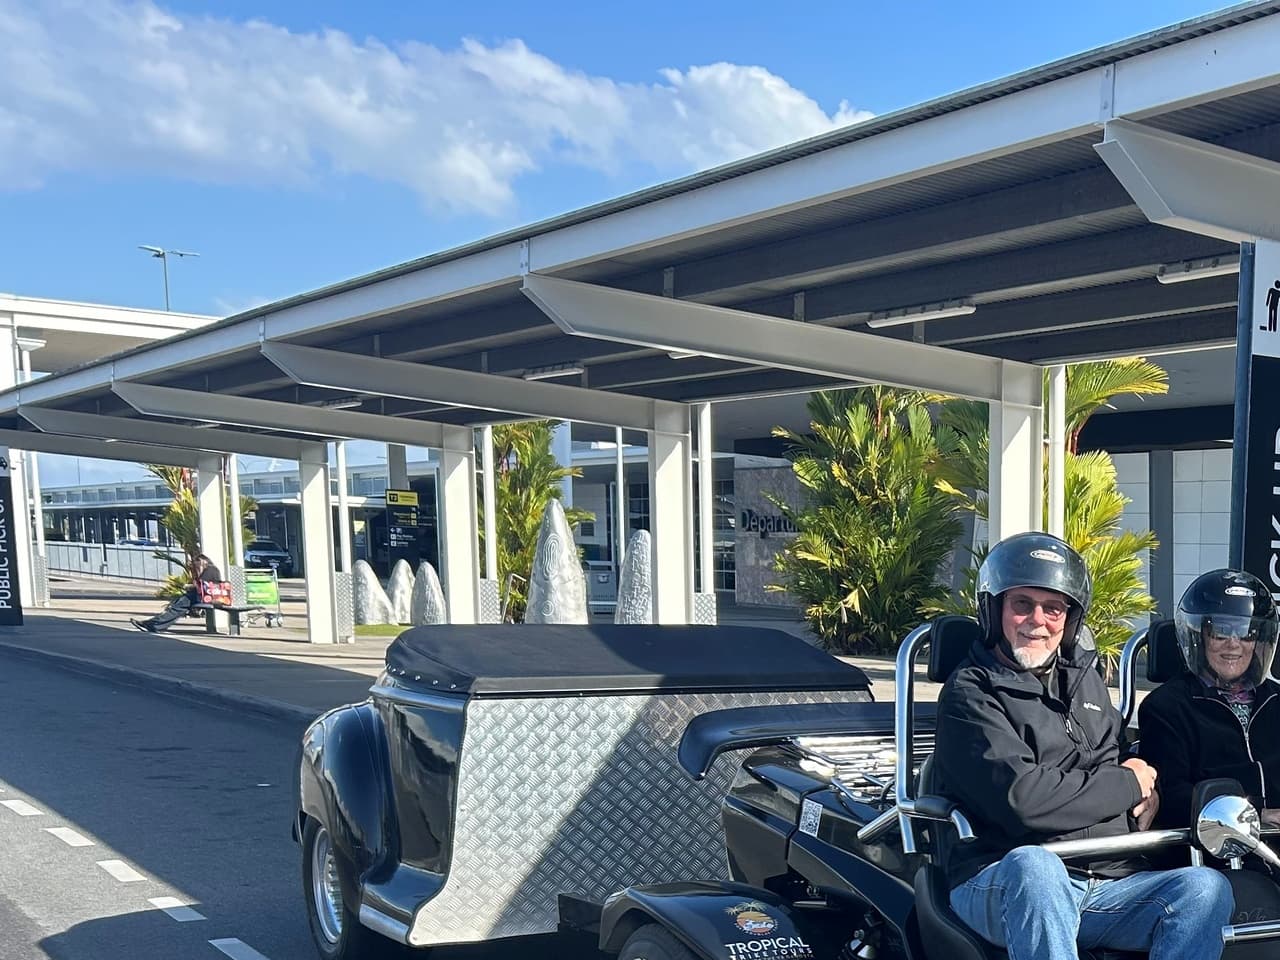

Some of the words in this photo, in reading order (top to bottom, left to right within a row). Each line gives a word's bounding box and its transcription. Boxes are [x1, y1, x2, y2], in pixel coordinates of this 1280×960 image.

[741, 509, 801, 538] Departu
[0, 557, 12, 609] PUBLIC
[725, 936, 810, 955] TROPICAL
[772, 947, 813, 957] TOURS
